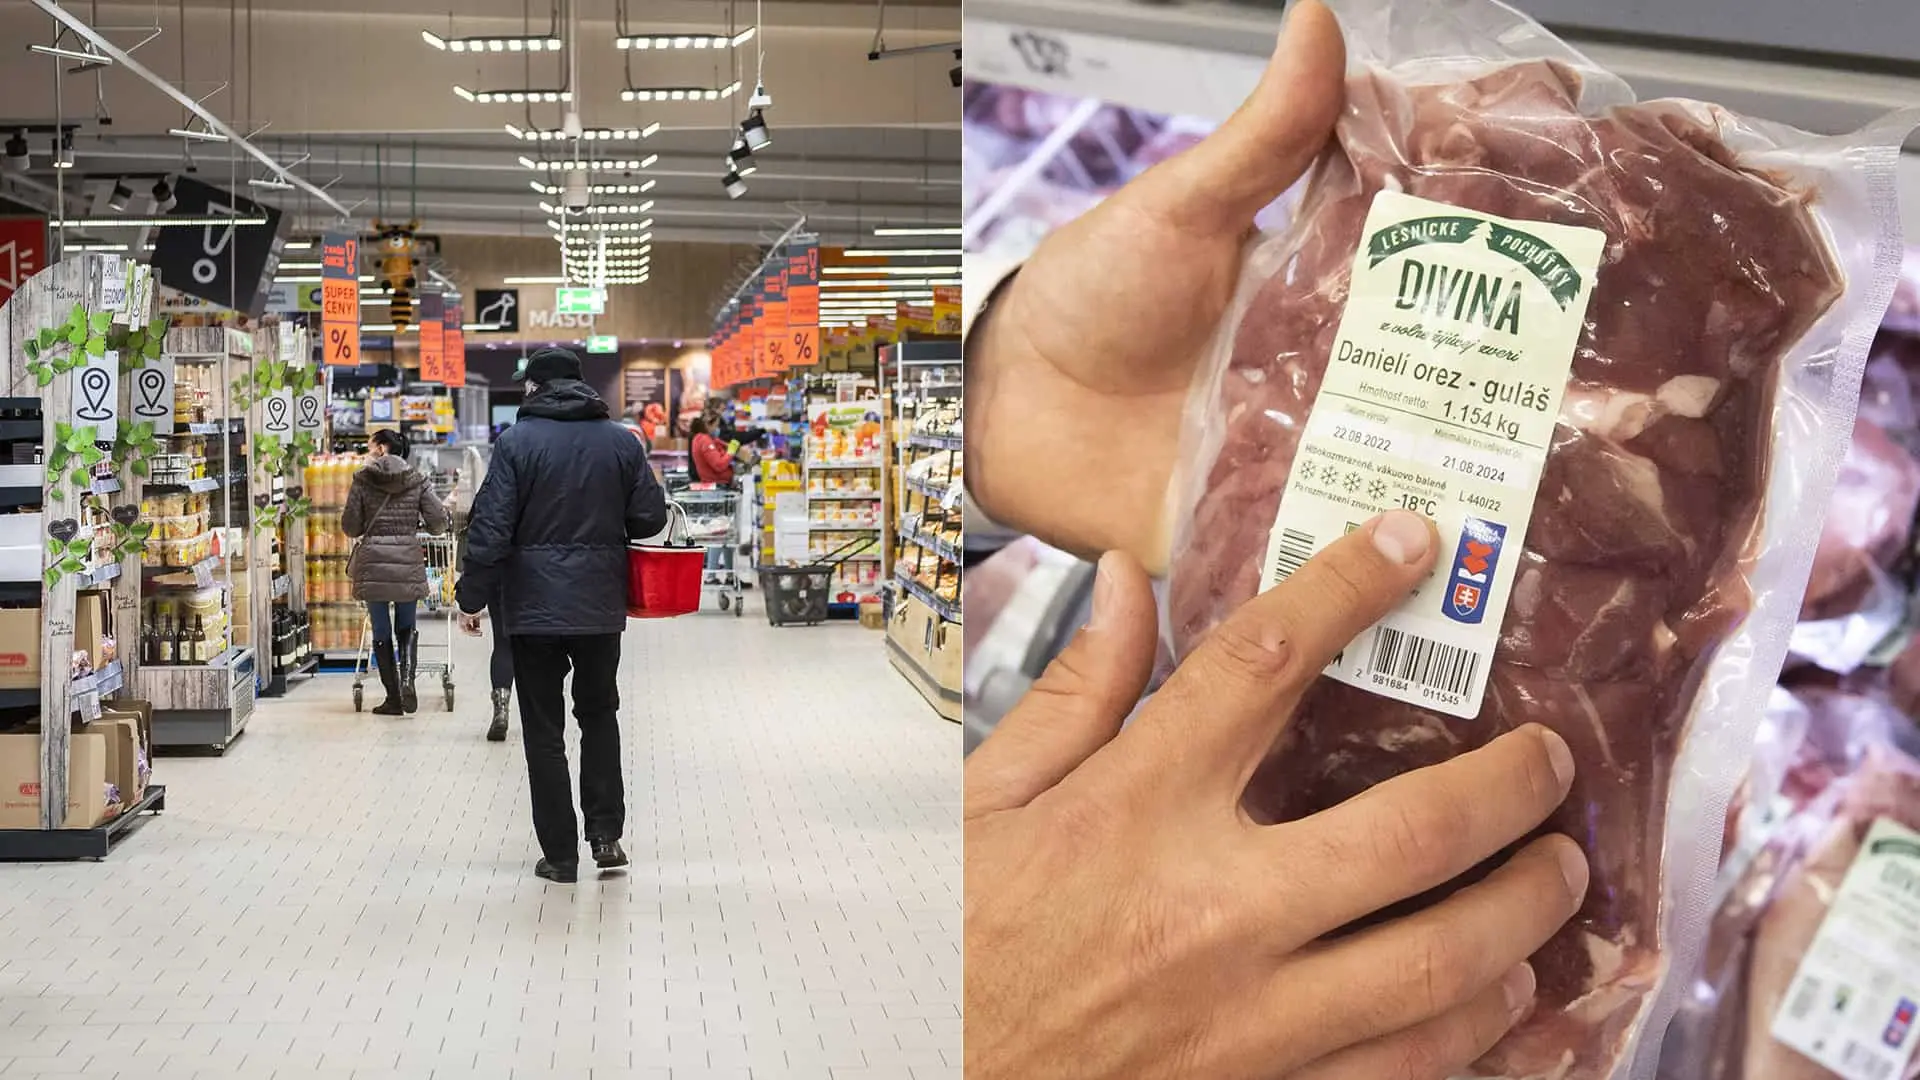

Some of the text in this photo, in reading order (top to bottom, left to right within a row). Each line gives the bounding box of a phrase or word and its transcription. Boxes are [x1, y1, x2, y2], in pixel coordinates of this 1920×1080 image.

[324, 286, 355, 299] SUPER
[1395, 258, 1522, 335] DIVINA
[1413, 362, 1463, 390] orez
[1482, 378, 1551, 413] guláš
[1402, 393, 1430, 410] netto:
[1442, 400, 1493, 429] 1.154
[1496, 413, 1521, 441] kg
[1333, 425, 1392, 453] 22.08.2022
[1415, 473, 1447, 490] balené
[1442, 455, 1506, 483] 21.08.2024
[1350, 500, 1377, 513] znova
[1466, 493, 1502, 513] 440/22
[1354, 668, 1363, 679] 2
[1372, 673, 1409, 692] 981684
